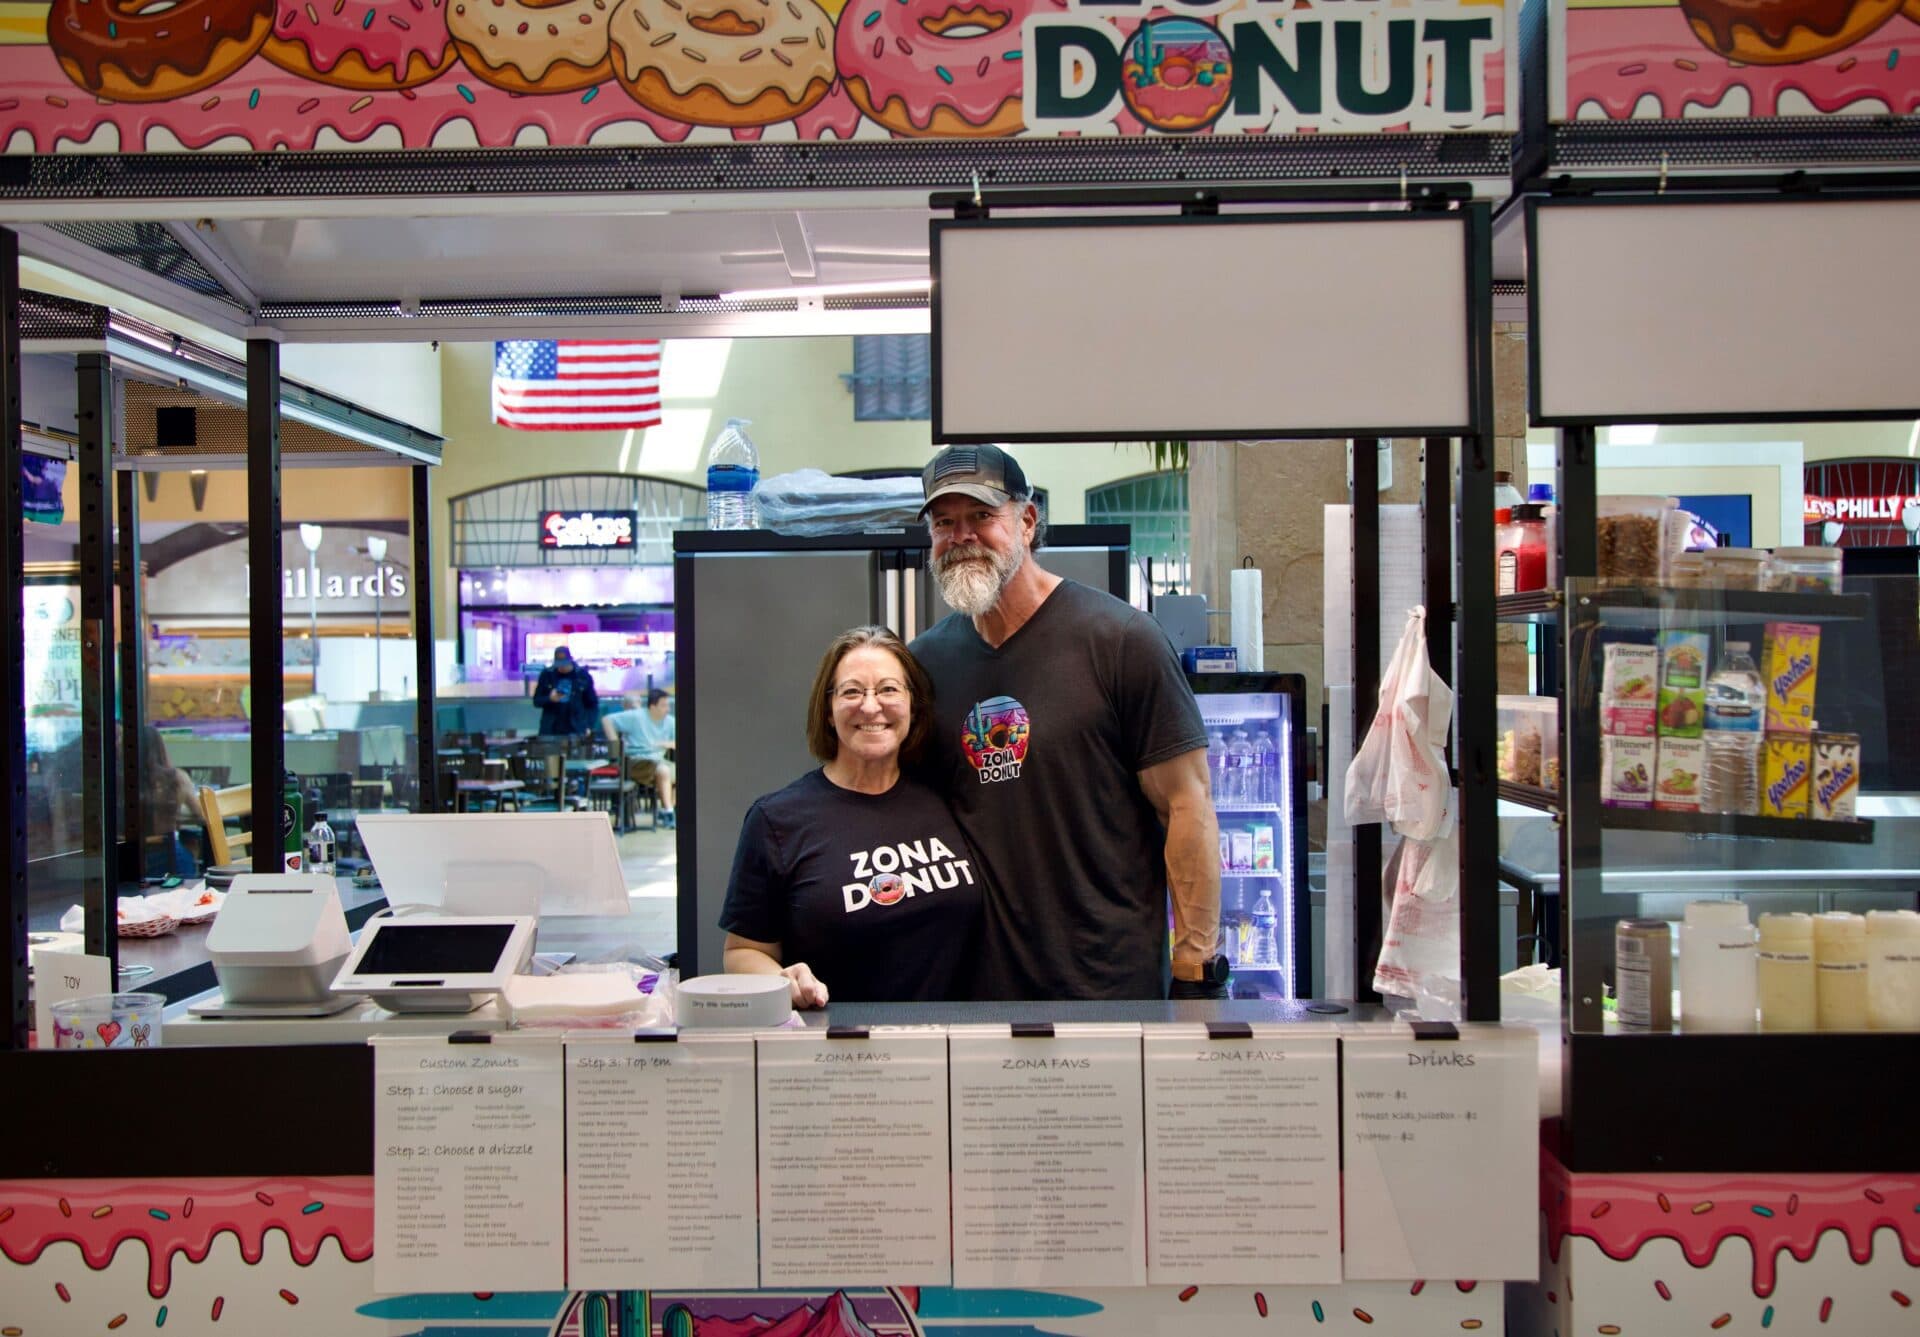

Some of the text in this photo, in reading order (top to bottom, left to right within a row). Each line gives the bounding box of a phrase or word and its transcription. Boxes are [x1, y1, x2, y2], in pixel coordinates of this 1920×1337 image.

[1035, 15, 1493, 133] DONUT
[1804, 502, 1836, 518] LEYS
[1836, 496, 1901, 519] PHILLY
[245, 564, 406, 598] illard's
[982, 749, 1017, 768] ZONA
[979, 762, 1022, 784] DONUT
[850, 837, 956, 879] ZONA
[842, 860, 974, 913] DONUT
[64, 975, 81, 990] TOY
[420, 1057, 519, 1069] Custom Zonuts
[577, 1057, 607, 1071] Step
[608, 1057, 621, 1068] 3:
[626, 1057, 648, 1071] Top
[814, 1052, 891, 1064] ZONA FAVS
[1001, 1058, 1091, 1070] ZONA FAVS
[1196, 1050, 1285, 1062] ZONA FAVS
[1408, 1050, 1475, 1068] Drinks
[386, 1085, 525, 1101] Step 1: Choose a sugar
[386, 1143, 533, 1160] Step 2: Choose a drizzle
